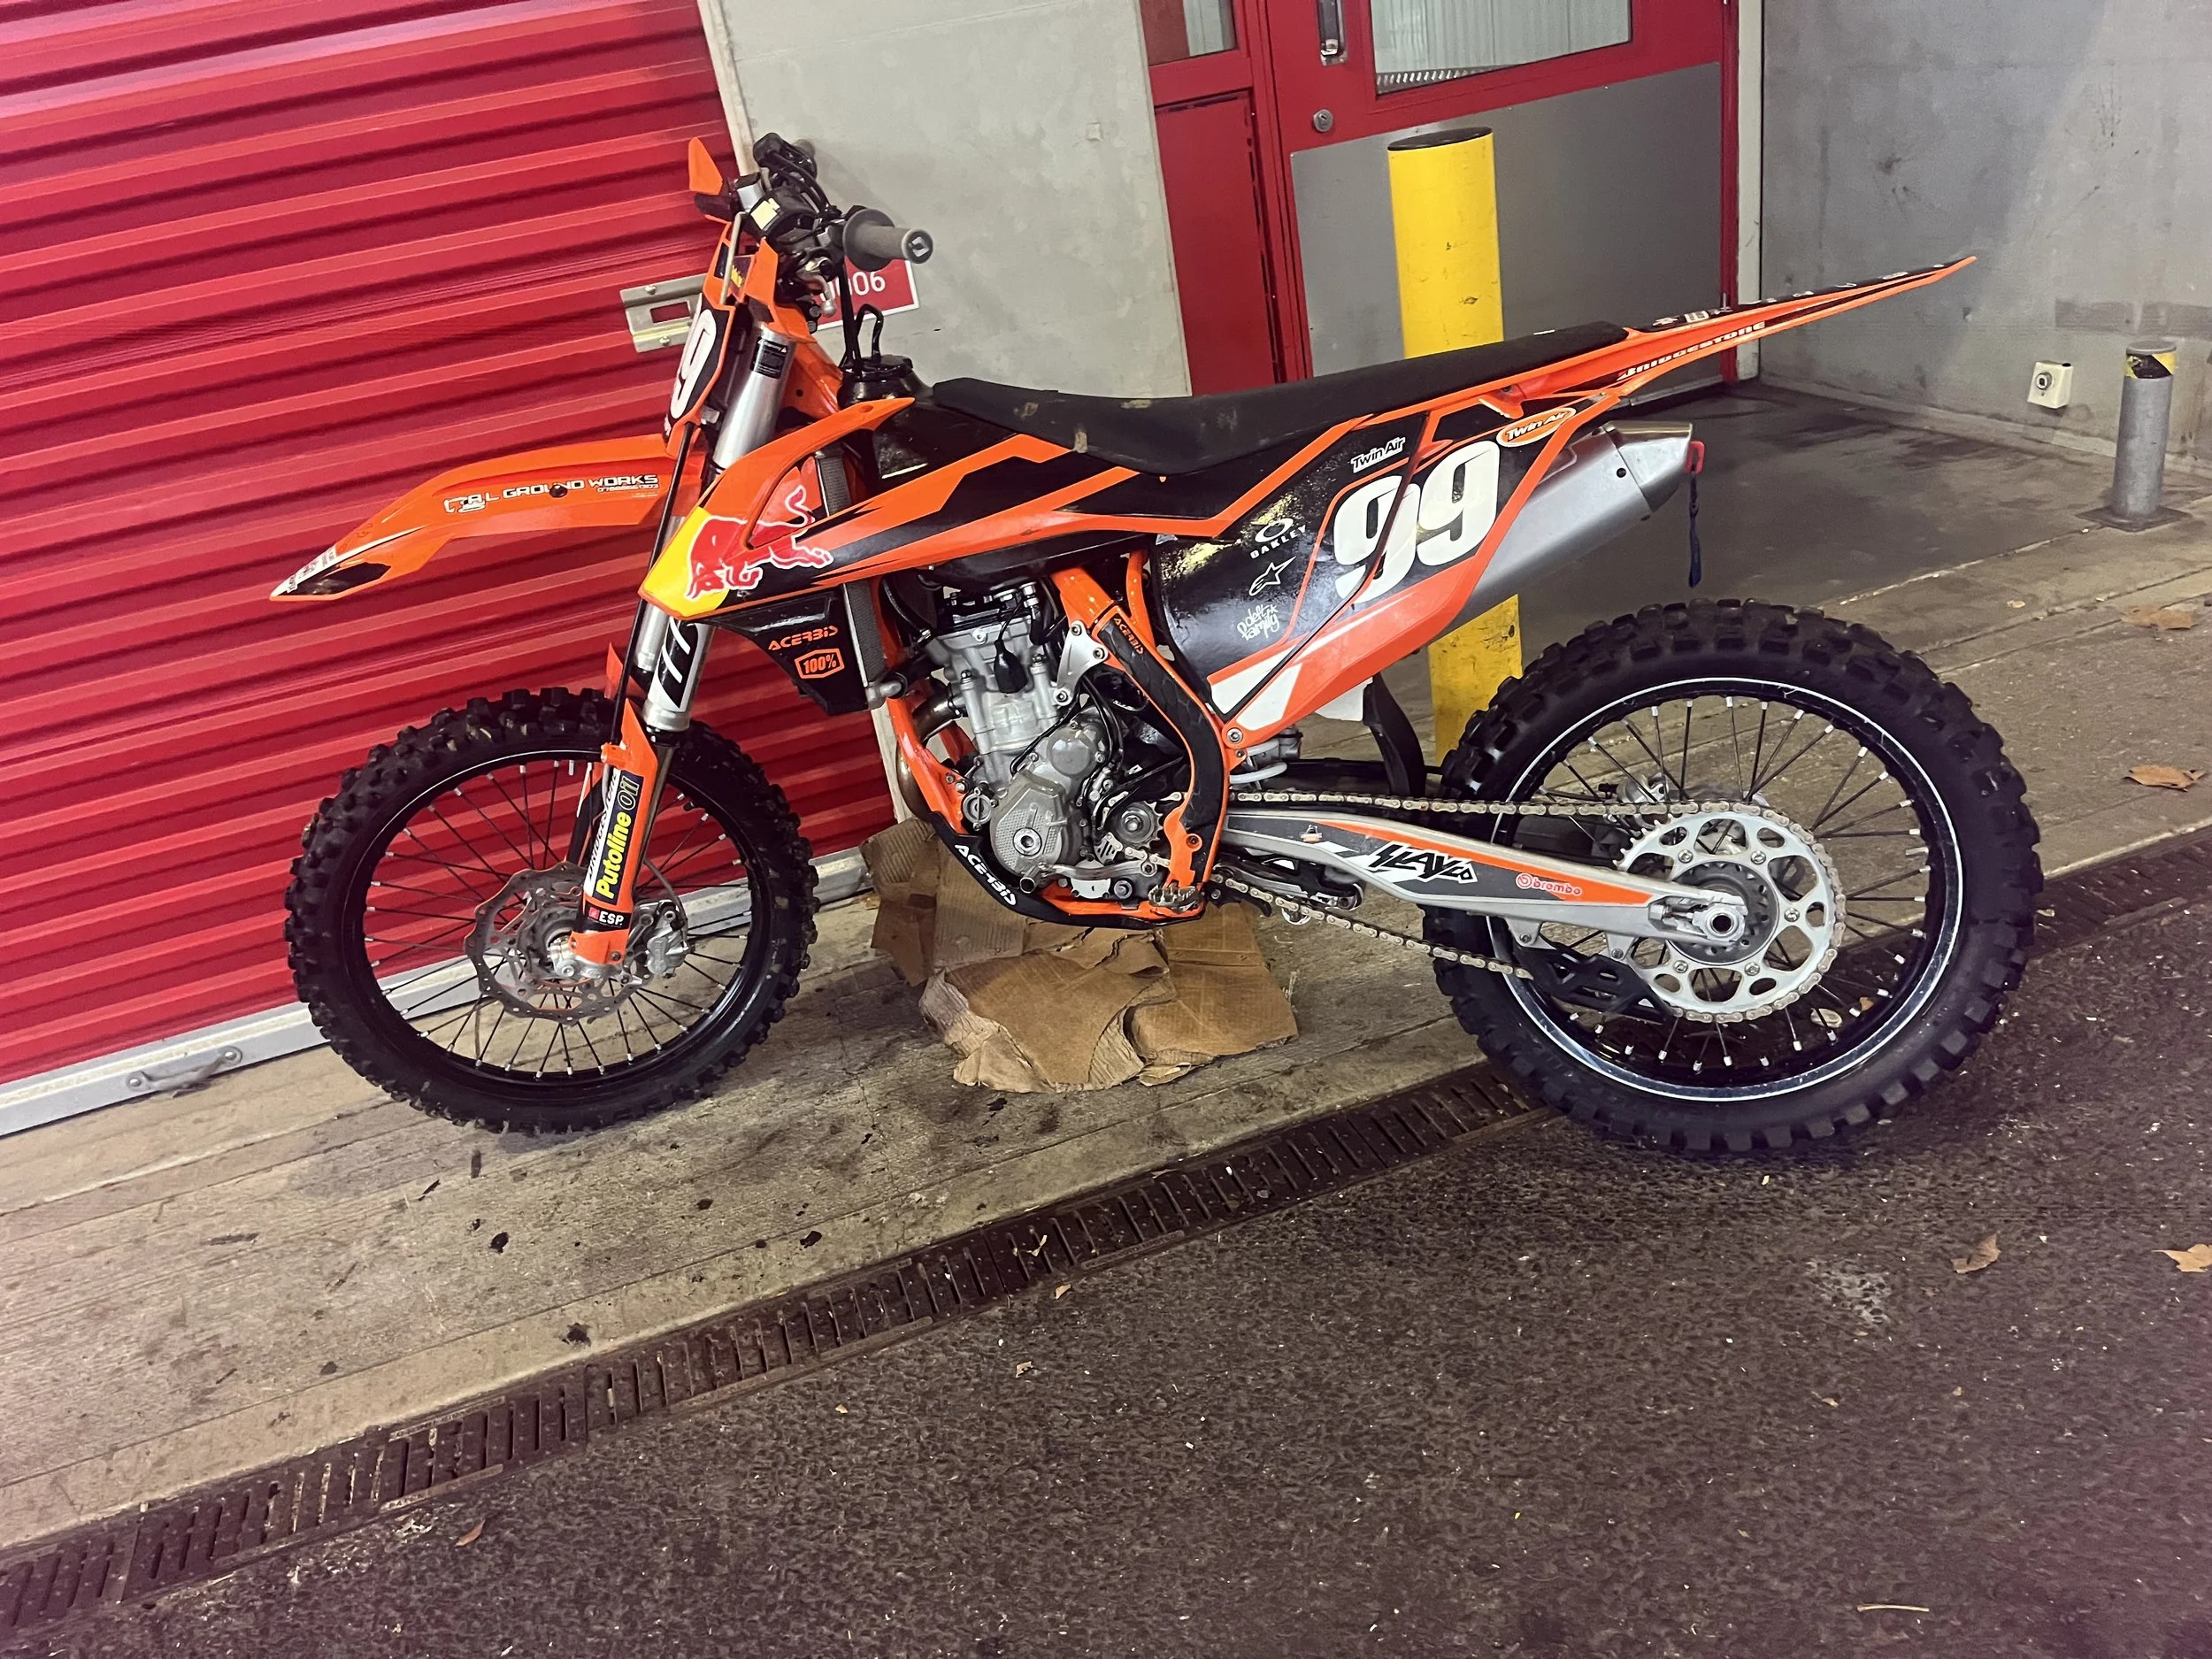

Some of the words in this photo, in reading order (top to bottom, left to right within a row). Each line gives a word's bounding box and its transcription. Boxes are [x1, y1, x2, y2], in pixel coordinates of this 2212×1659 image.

[1506, 419, 1543, 442] Twin
[1543, 411, 1570, 425] Air
[1351, 449, 1384, 470] Twin
[1384, 437, 1405, 455] Air
[588, 473, 659, 488] WORKS
[1333, 441, 1501, 603] 99
[1249, 524, 1307, 559] OAKLEY
[768, 625, 839, 651] ACERBIS
[1113, 618, 1144, 655] ACERBIS
[803, 653, 838, 674] 100%
[595, 811, 632, 899] Putoline
[617, 774, 640, 810] Oil
[955, 844, 1017, 906] ACERBIS
[1532, 877, 1582, 895] brembo
